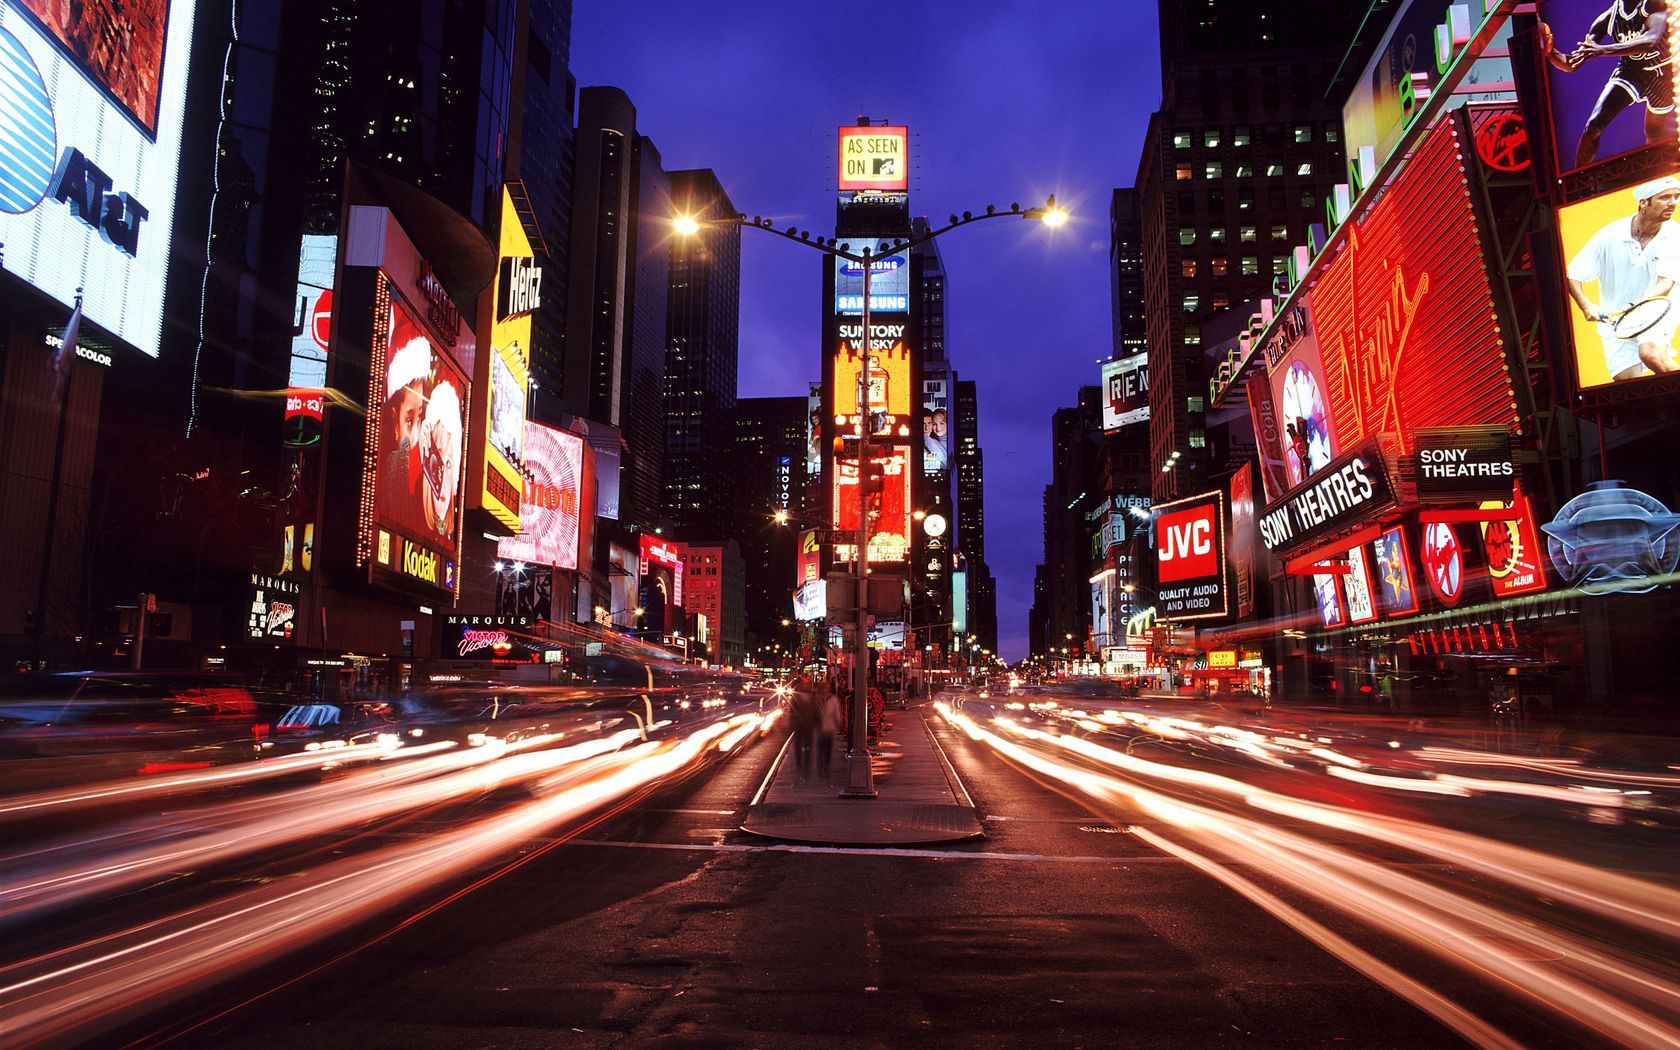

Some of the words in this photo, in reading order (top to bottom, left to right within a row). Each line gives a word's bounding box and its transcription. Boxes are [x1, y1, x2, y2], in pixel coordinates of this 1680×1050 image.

[848, 139, 863, 154] AS
[867, 139, 898, 154] SEEN
[847, 159, 866, 175] ON
[872, 158, 895, 175] MTV
[49, 146, 149, 260] AT&T
[509, 256, 542, 315] Hertz
[850, 339, 895, 350] WISKY
[1338, 224, 1429, 450] Virgin
[45, 334, 112, 367] SPEACOLOR
[1260, 400, 1277, 443] Cola
[1420, 449, 1468, 463] SONY
[1421, 462, 1513, 478] THEATRES
[1259, 505, 1293, 550] SONY
[1289, 458, 1373, 534] THEATRES
[1158, 518, 1211, 562] JVC
[403, 540, 437, 583] Kodak
[251, 573, 300, 594] MARQUIS
[1119, 555, 1129, 626] PALACE
[1513, 574, 1535, 588] ALBUM
[1159, 588, 1190, 601] QUALITY
[1193, 584, 1219, 597] AUDIO
[1167, 601, 1183, 611] AND
[1186, 597, 1210, 609] VIDEO
[448, 616, 528, 625] MARQUIS
[464, 631, 506, 642] VICTOR
